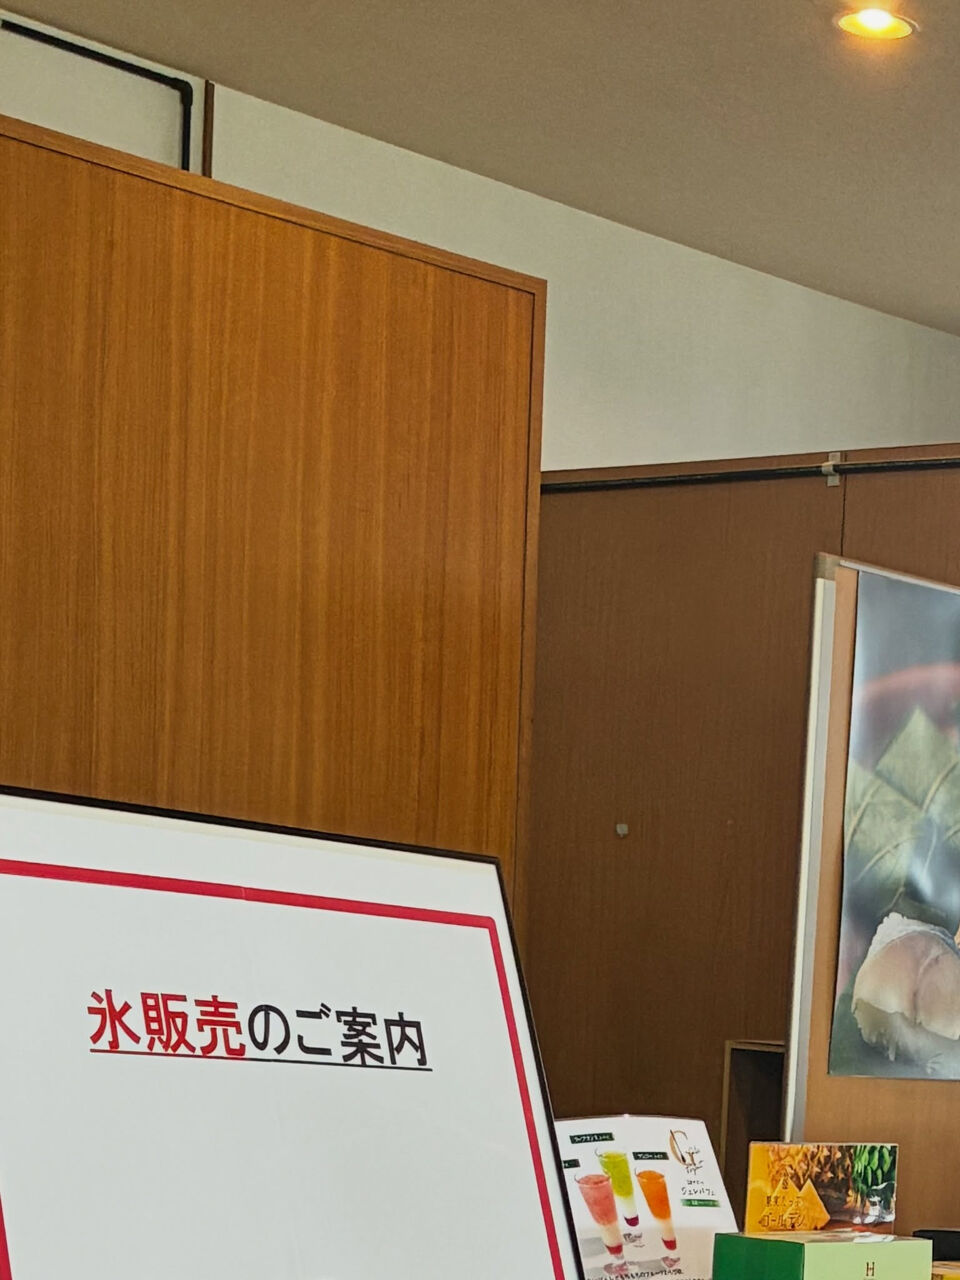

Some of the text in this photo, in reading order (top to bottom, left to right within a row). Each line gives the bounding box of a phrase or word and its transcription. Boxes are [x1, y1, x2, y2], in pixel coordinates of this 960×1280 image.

[87, 988, 430, 1068] 氷販売のご案内
